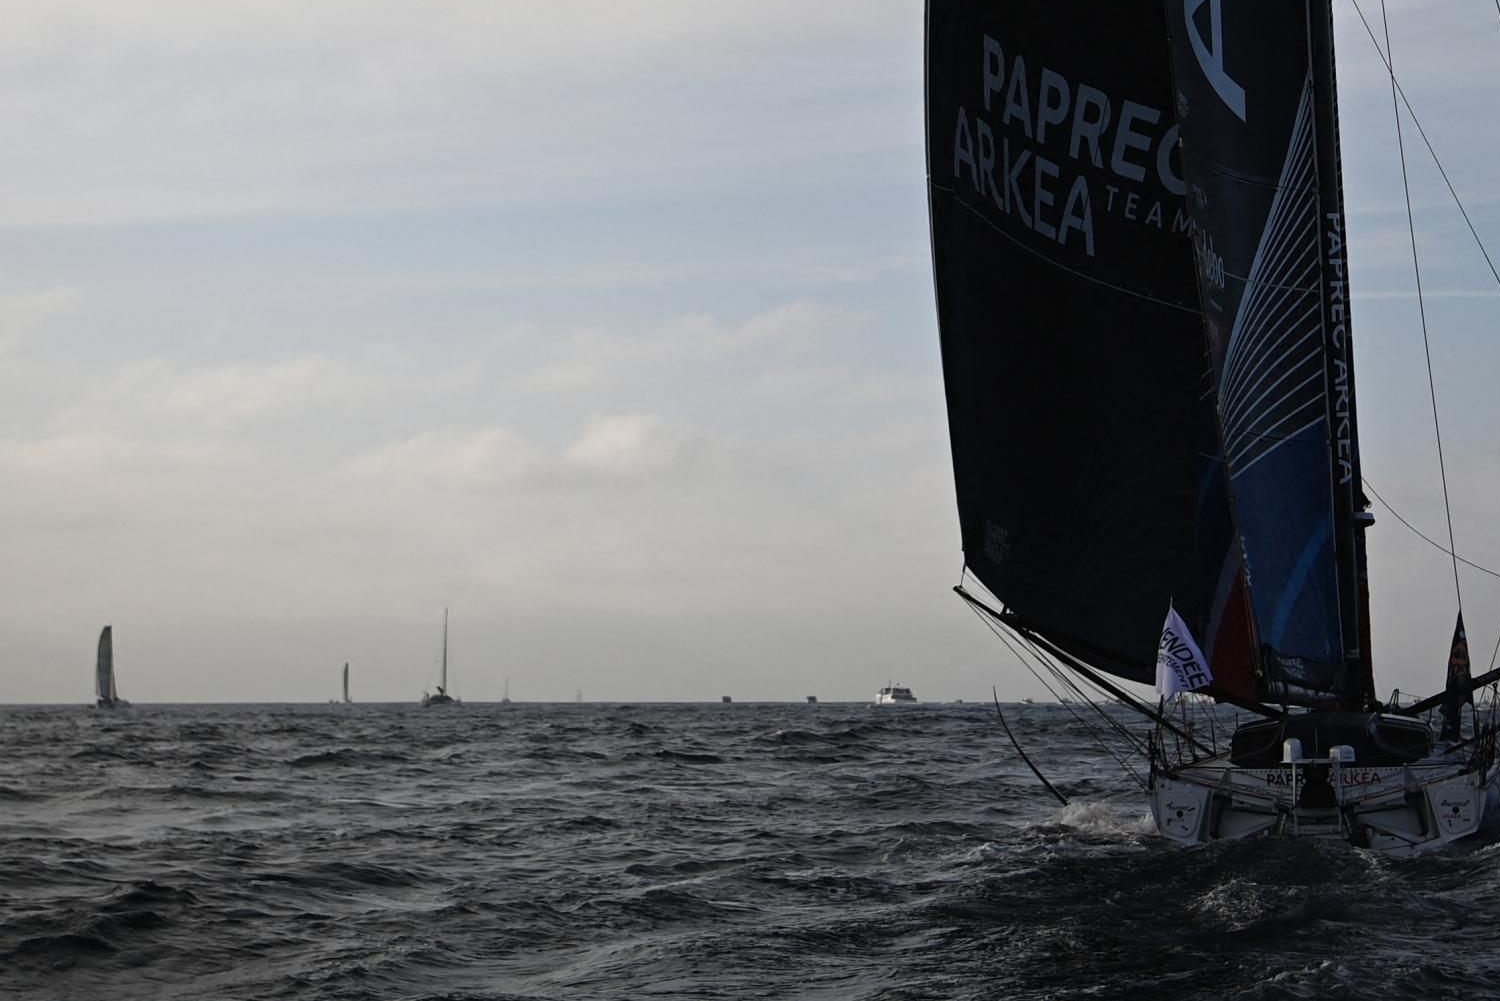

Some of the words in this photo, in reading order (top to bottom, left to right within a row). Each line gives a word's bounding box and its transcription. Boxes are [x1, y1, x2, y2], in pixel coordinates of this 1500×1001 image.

[953, 105, 1095, 257] ARKEA
[1326, 212, 1346, 349] PAPREC
[1333, 359, 1352, 485] ARKEA
